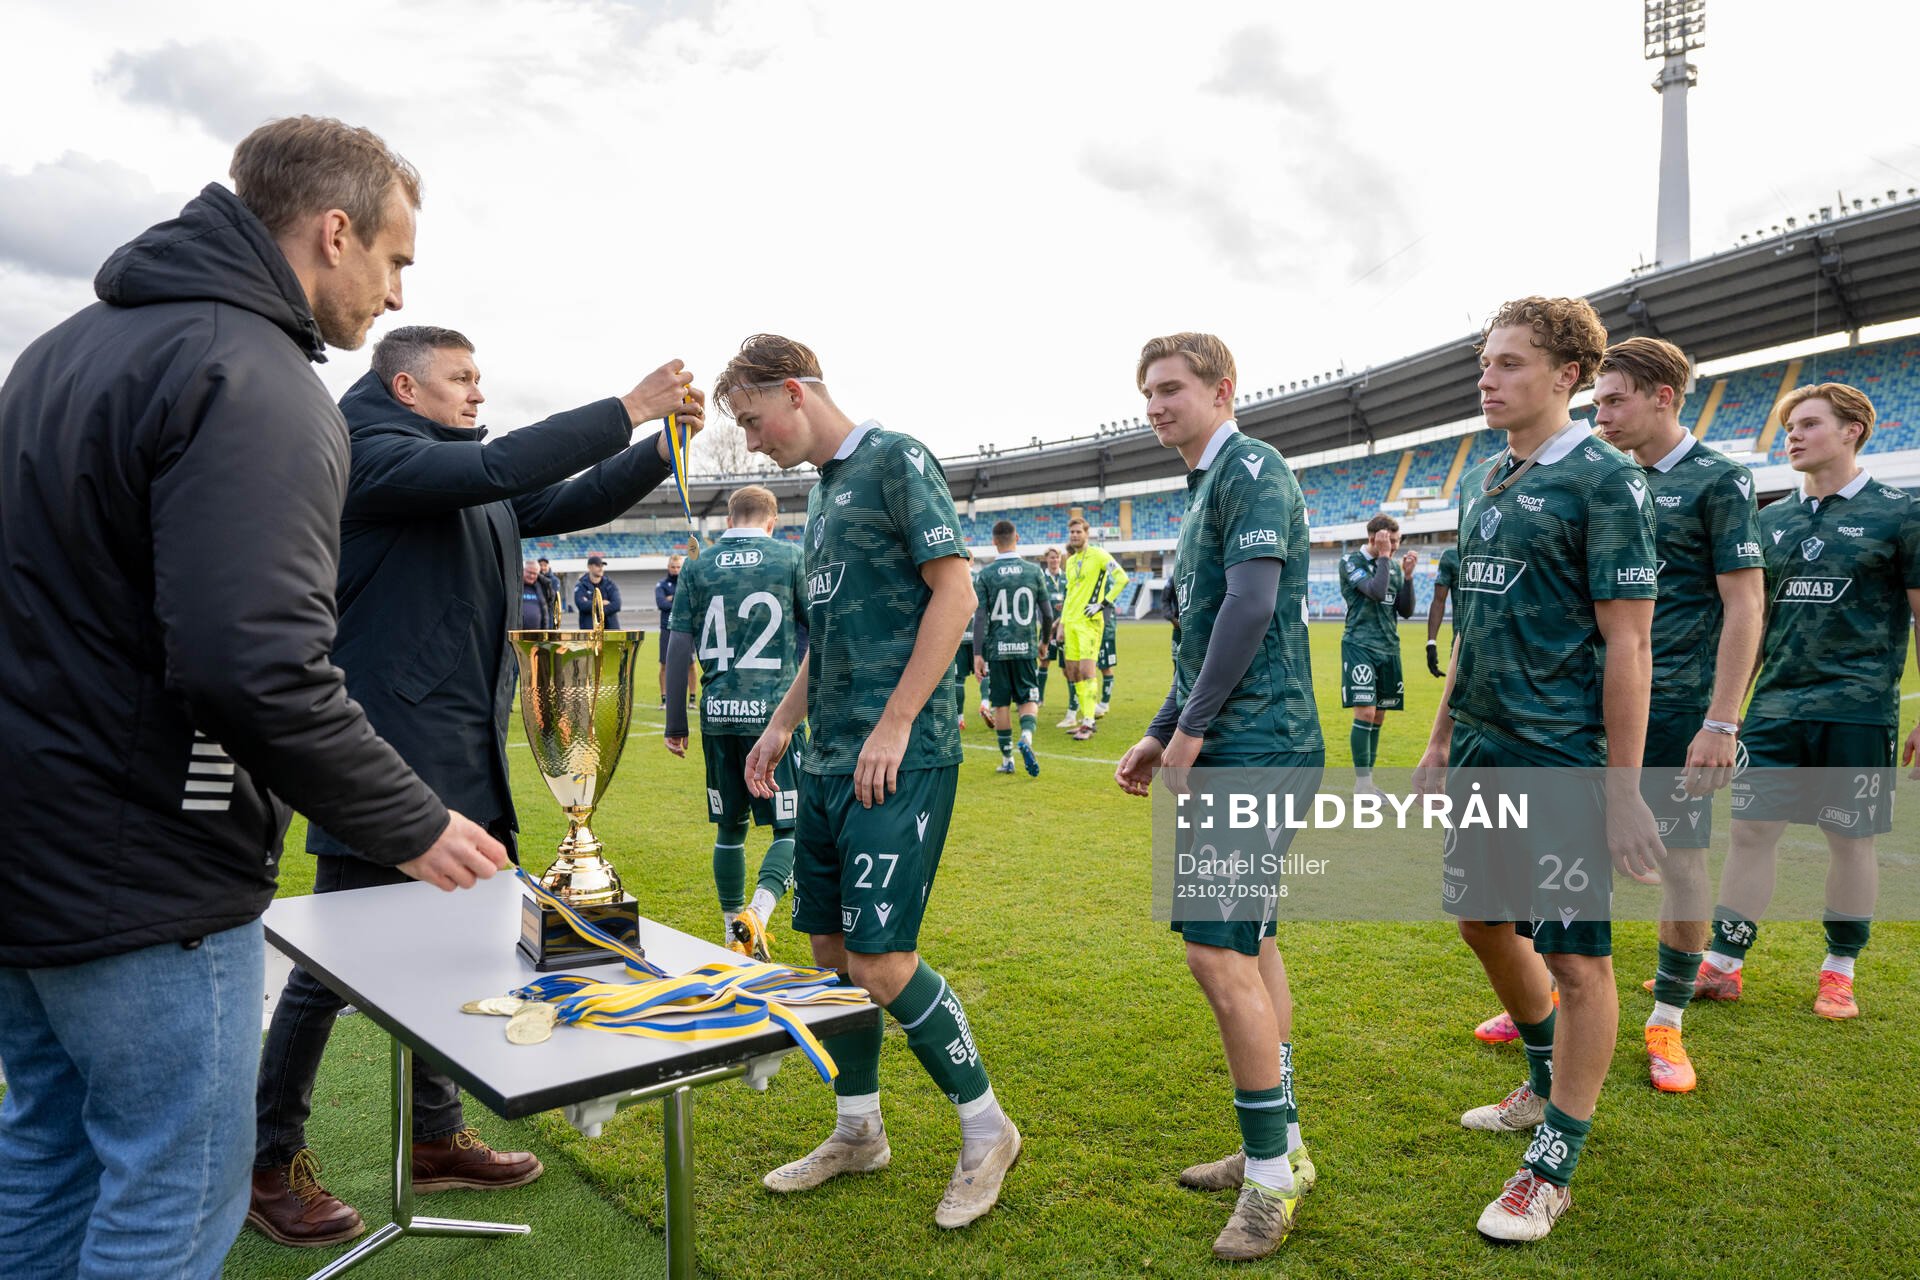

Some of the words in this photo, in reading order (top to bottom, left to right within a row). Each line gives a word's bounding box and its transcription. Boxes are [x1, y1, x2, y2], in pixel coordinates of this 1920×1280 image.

[1516, 494, 1546, 508] sport
[1521, 503, 1542, 512] ringen
[1655, 495, 1682, 504] sport
[1239, 529, 1278, 546] HFAB
[1837, 526, 1864, 534] sport
[720, 550, 759, 566] EAB
[1617, 566, 1656, 582] HFAB
[1785, 581, 1834, 597] JONAB
[990, 586, 1035, 626] 40
[699, 591, 783, 672] 42
[706, 696, 760, 716] ÖSTRAS
[1853, 773, 1881, 799] 28
[854, 853, 899, 889] 27
[1538, 854, 1589, 892] 26
[945, 1037, 968, 1065] GN
[1543, 1139, 1569, 1170] GN
